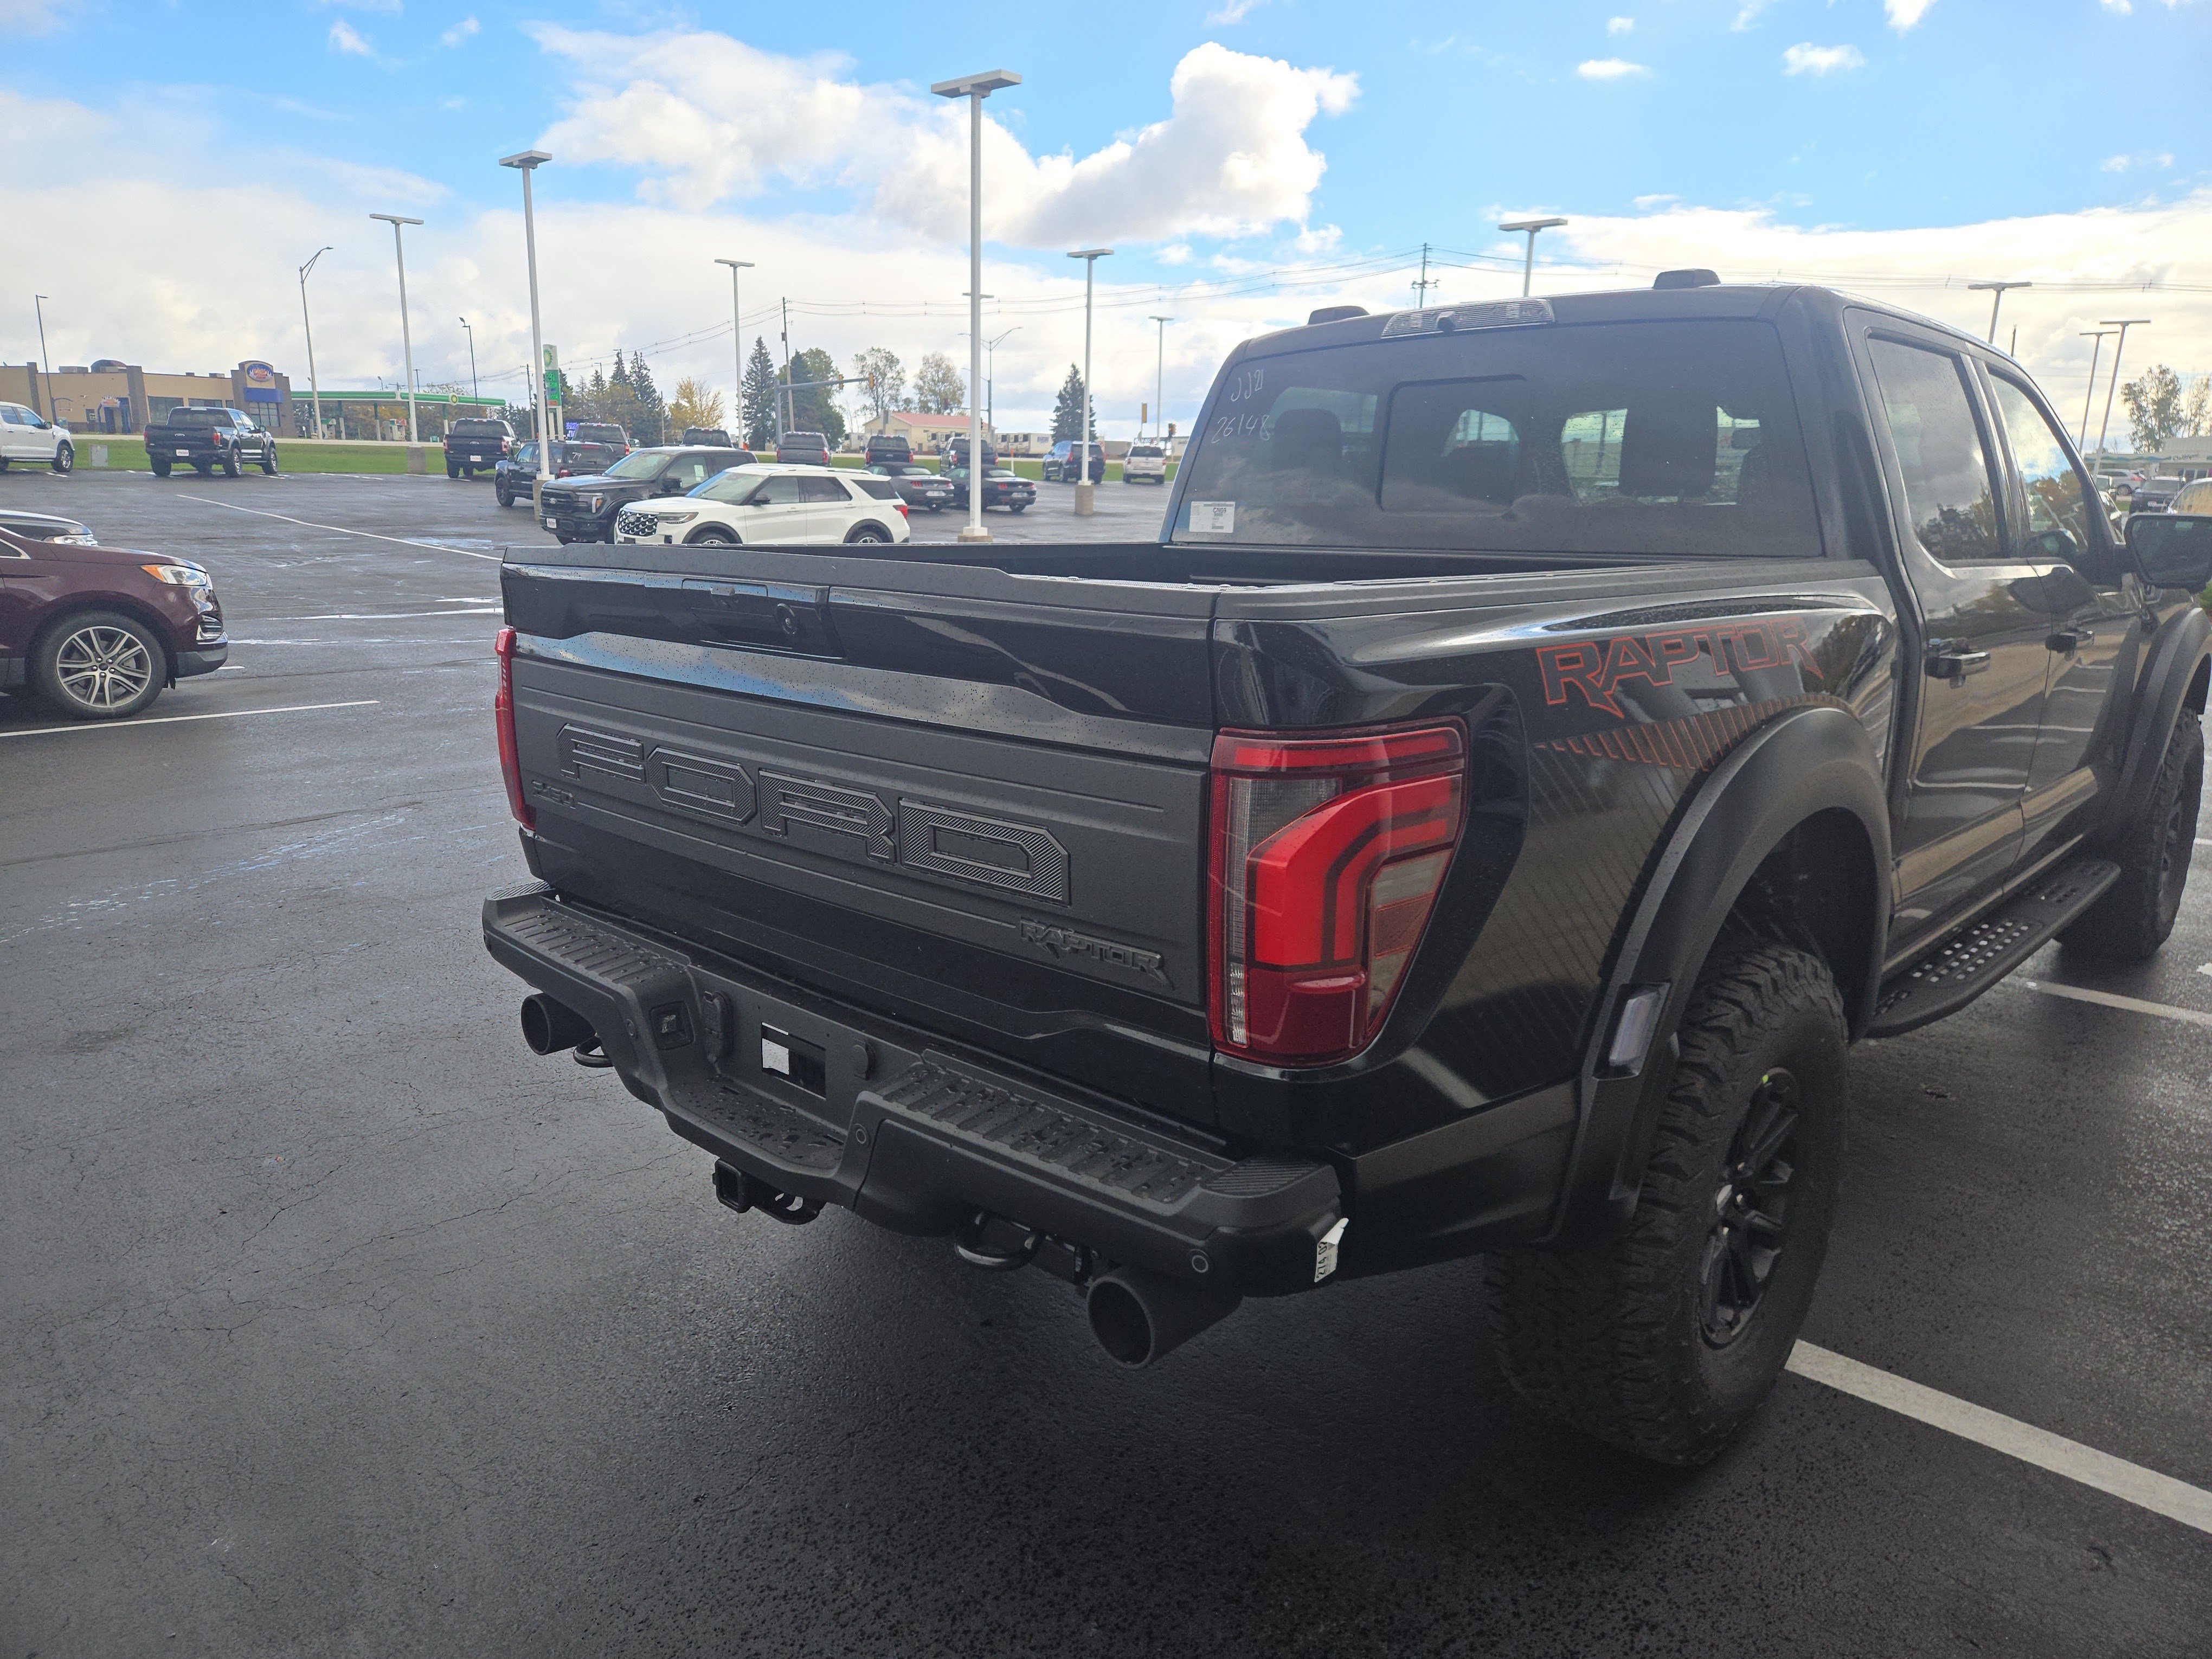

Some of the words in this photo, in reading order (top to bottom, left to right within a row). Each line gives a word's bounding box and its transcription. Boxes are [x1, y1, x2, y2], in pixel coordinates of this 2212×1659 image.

[1211, 414, 1270, 443] 26148
[1535, 617, 1824, 718] RAPTOR
[556, 724, 1072, 908] FORD
[1019, 917, 1175, 991] RAPTOR
